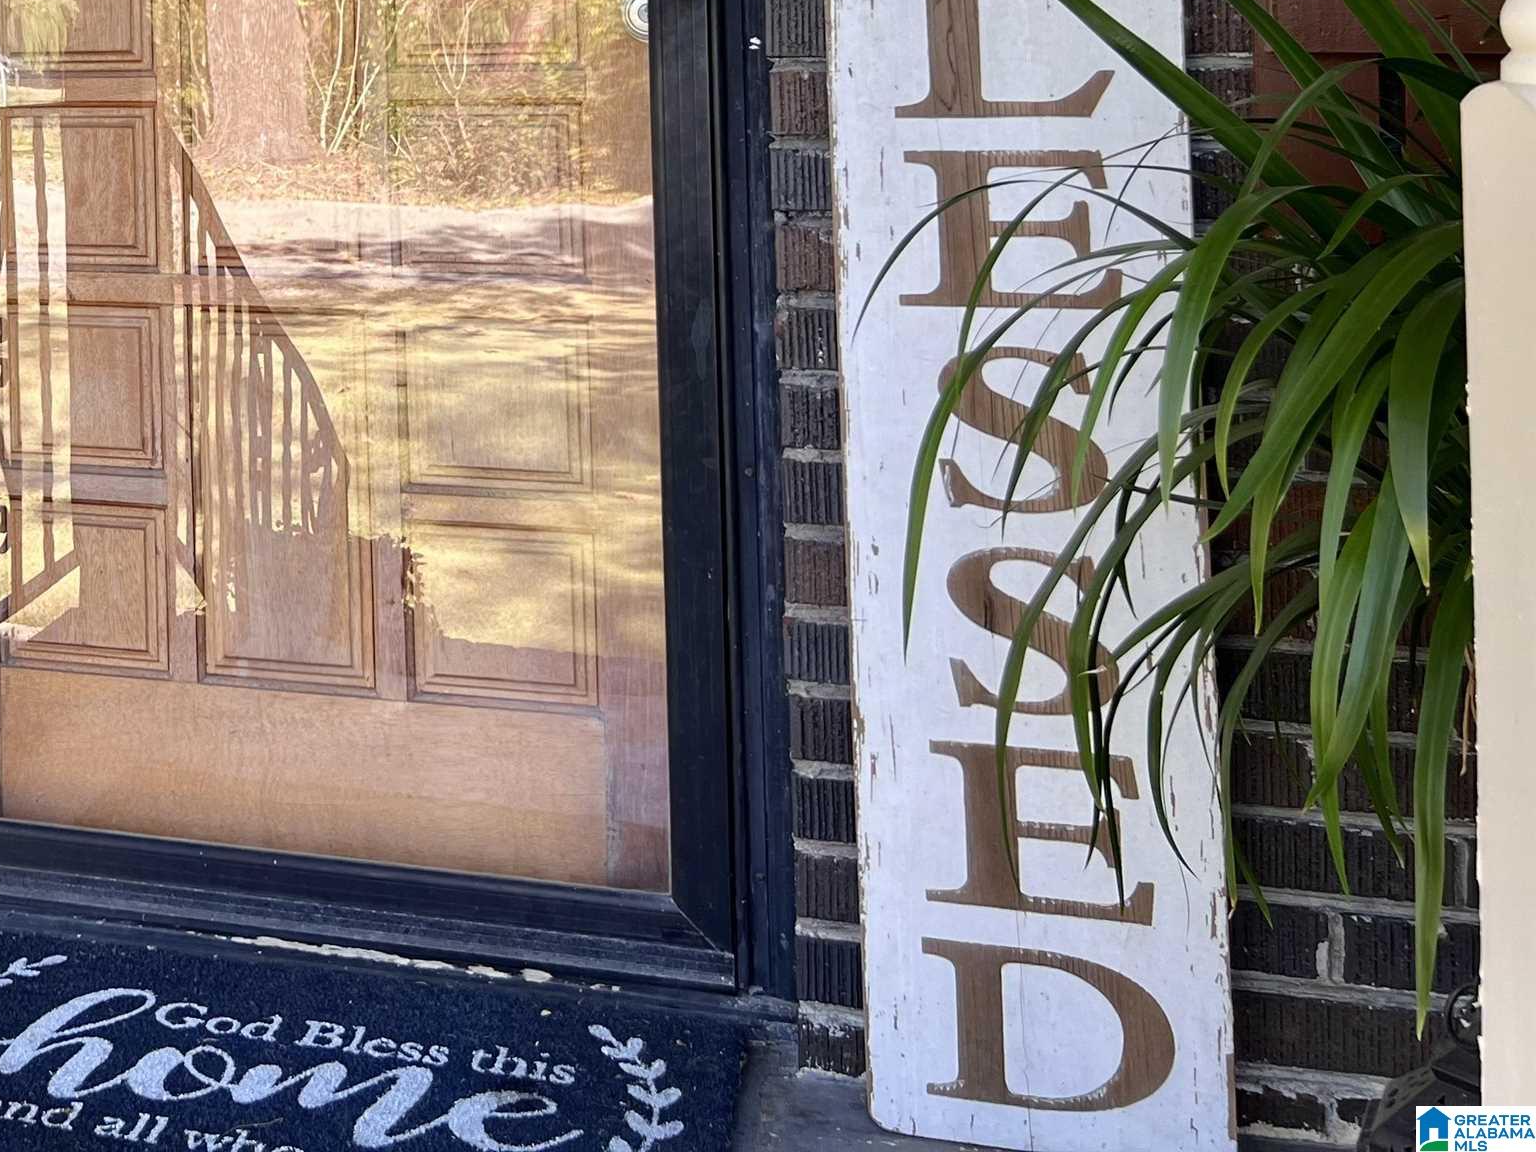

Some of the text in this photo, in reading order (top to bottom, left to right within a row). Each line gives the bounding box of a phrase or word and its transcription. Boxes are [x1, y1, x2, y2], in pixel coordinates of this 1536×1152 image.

[154, 1002, 576, 1085] God Bless this
[93, 1112, 169, 1145] all
